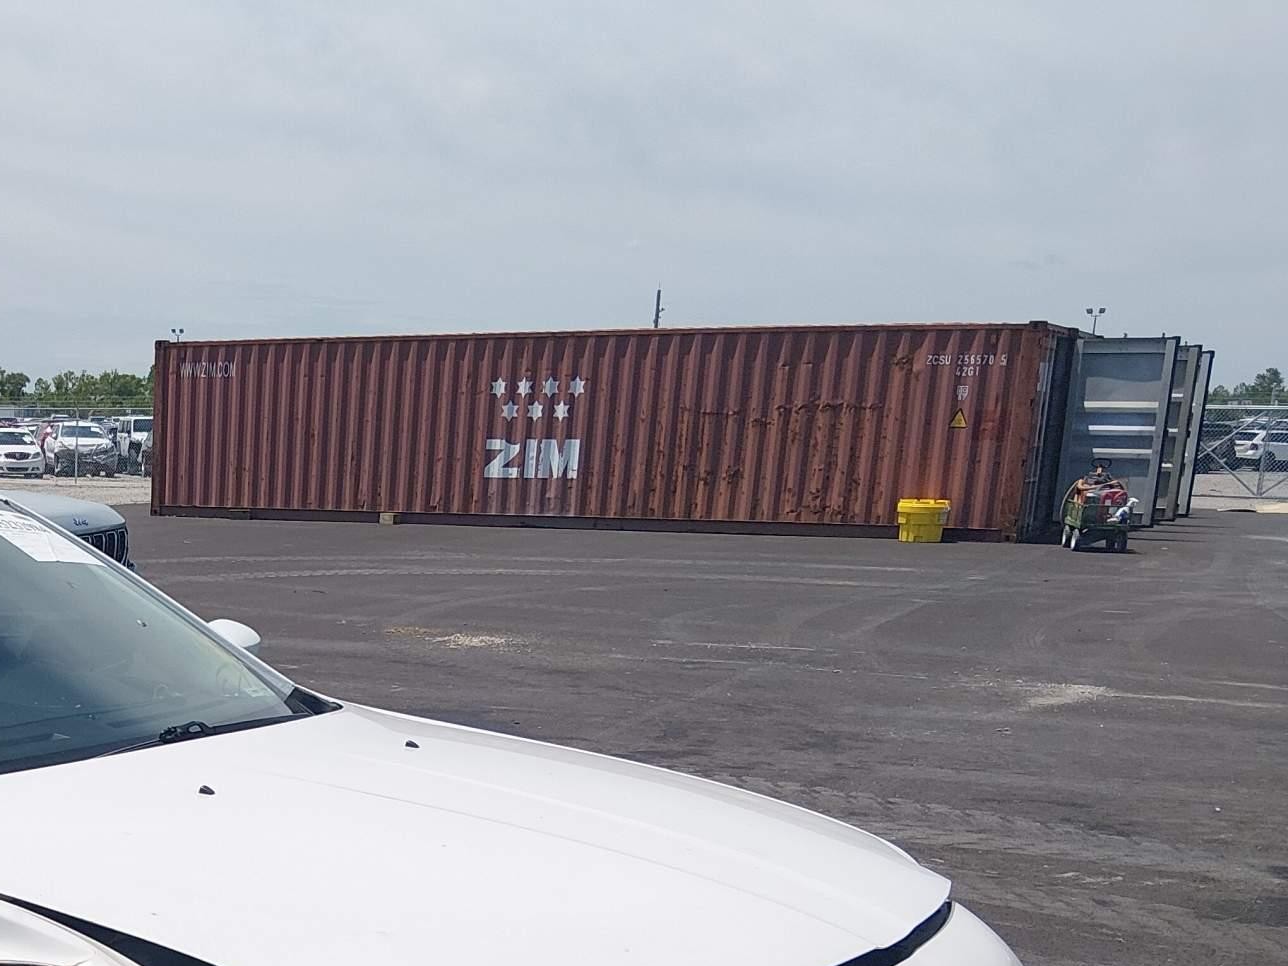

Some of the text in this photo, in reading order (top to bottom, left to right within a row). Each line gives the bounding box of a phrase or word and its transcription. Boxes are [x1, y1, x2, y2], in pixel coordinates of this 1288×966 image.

[926, 354, 952, 366] ZCSU
[958, 354, 995, 366] 256570
[483, 438, 581, 480] ZIM
